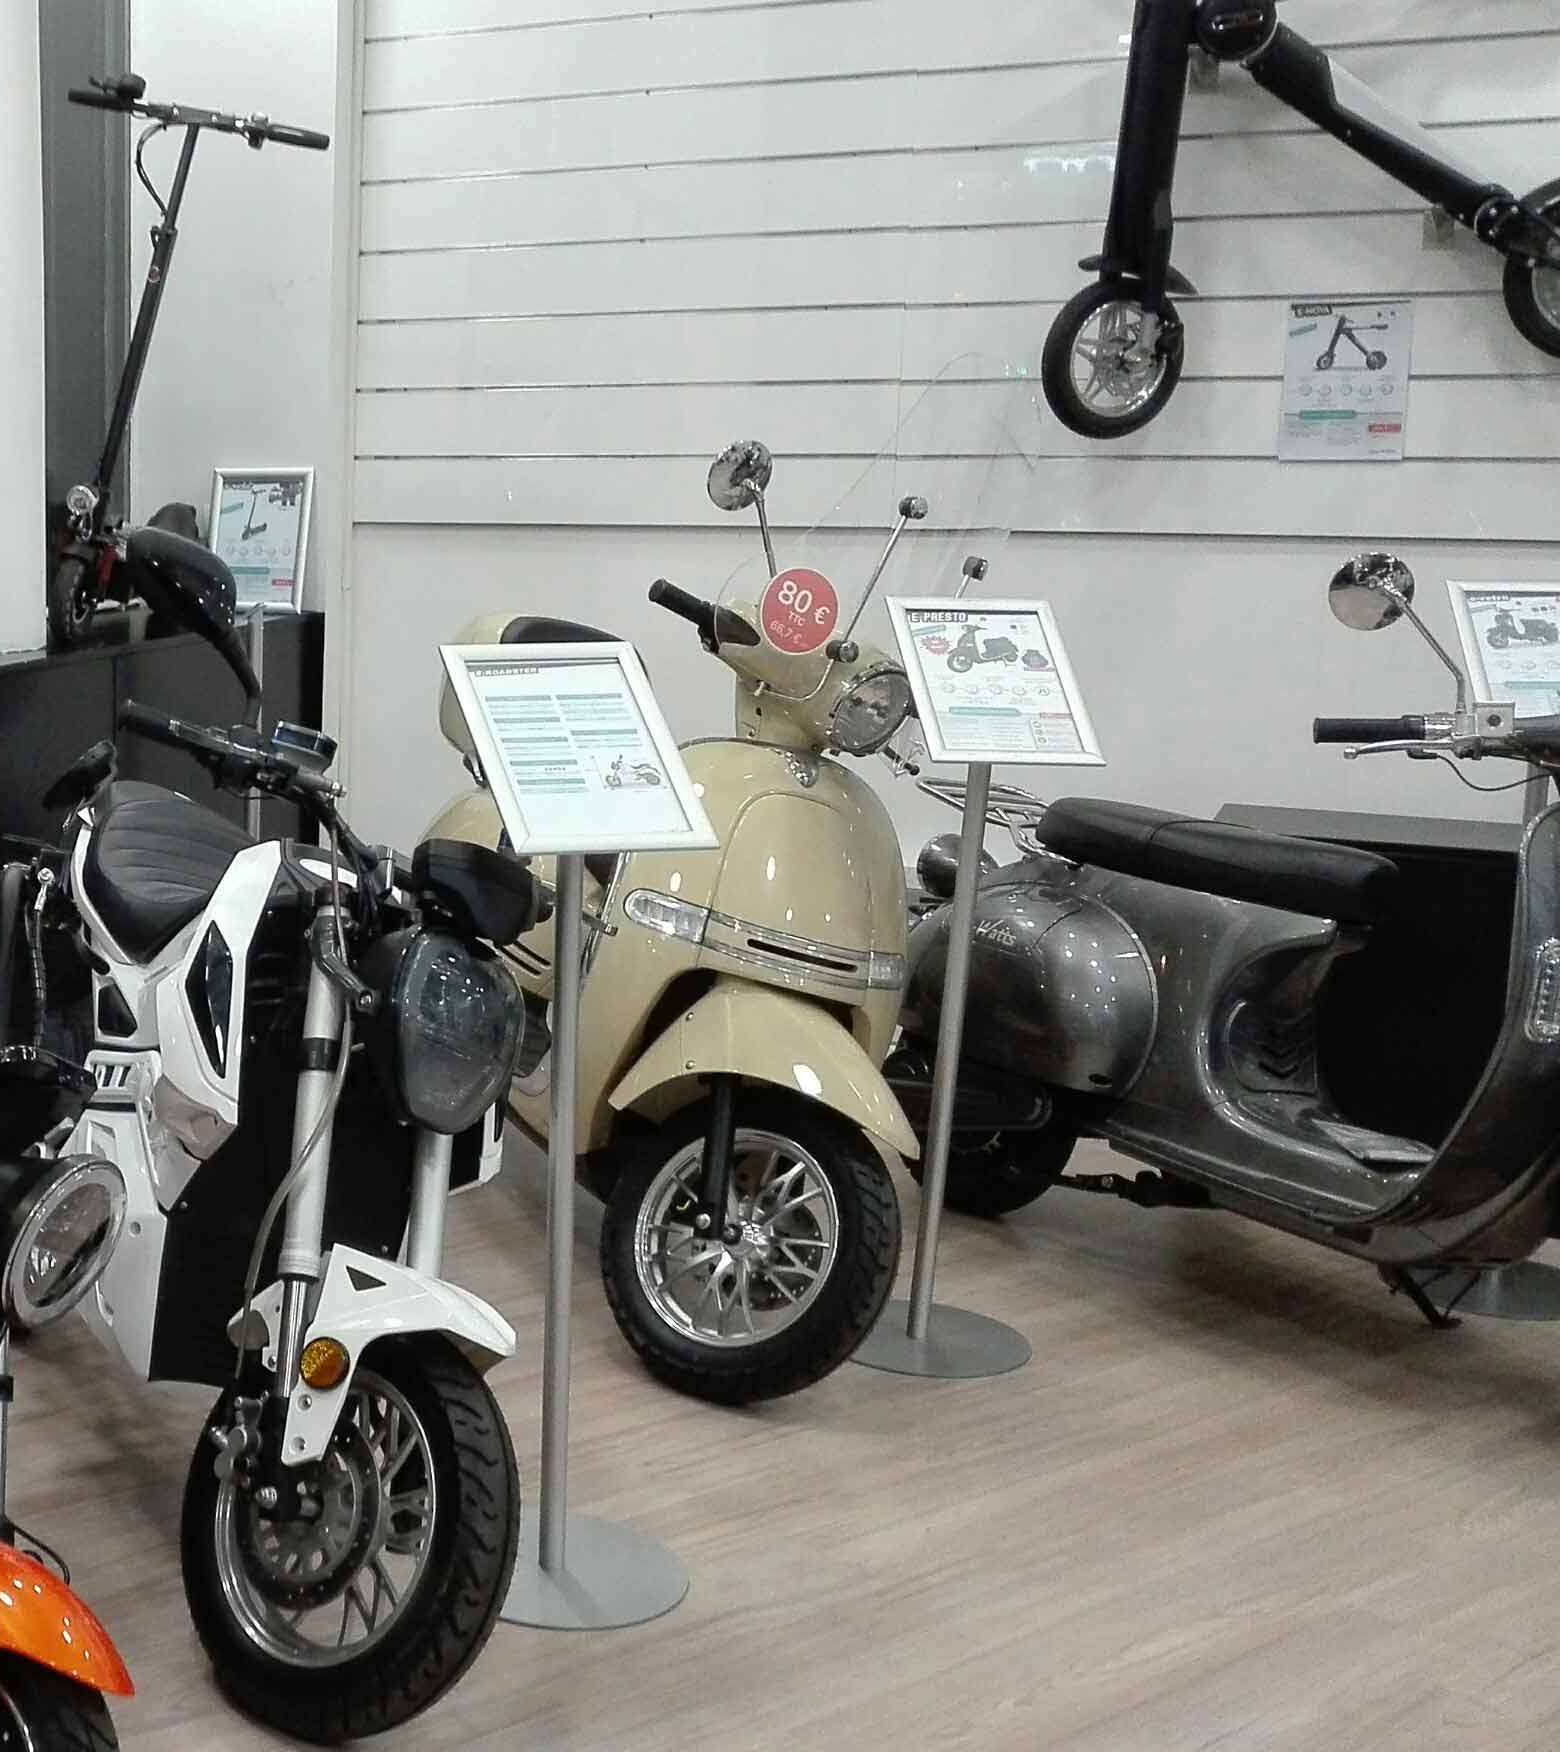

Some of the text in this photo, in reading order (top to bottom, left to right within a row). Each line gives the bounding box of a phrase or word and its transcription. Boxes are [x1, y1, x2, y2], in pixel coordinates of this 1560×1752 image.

[778, 580, 830, 625] 80 €
[788, 610, 806, 627] TTC
